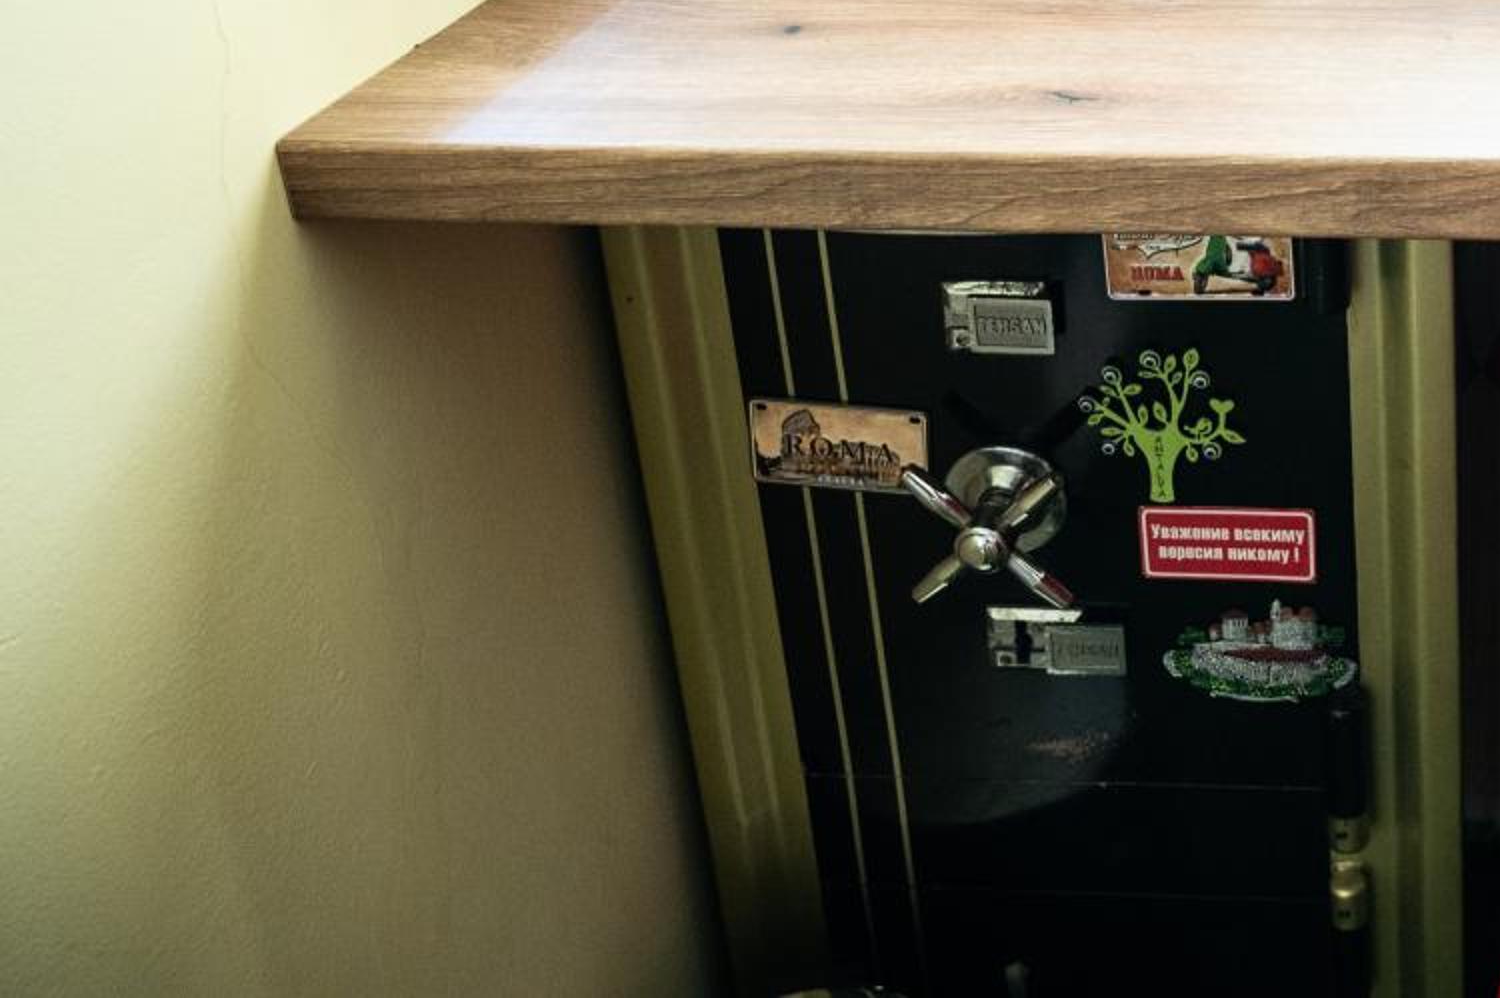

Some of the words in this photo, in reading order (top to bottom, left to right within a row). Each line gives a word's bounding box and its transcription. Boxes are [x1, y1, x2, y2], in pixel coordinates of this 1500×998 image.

[785, 433, 894, 464] ROMA
[1151, 524, 1231, 541] Уважение
[1233, 528, 1305, 545] всекиму
[1227, 548, 1290, 565] никому
